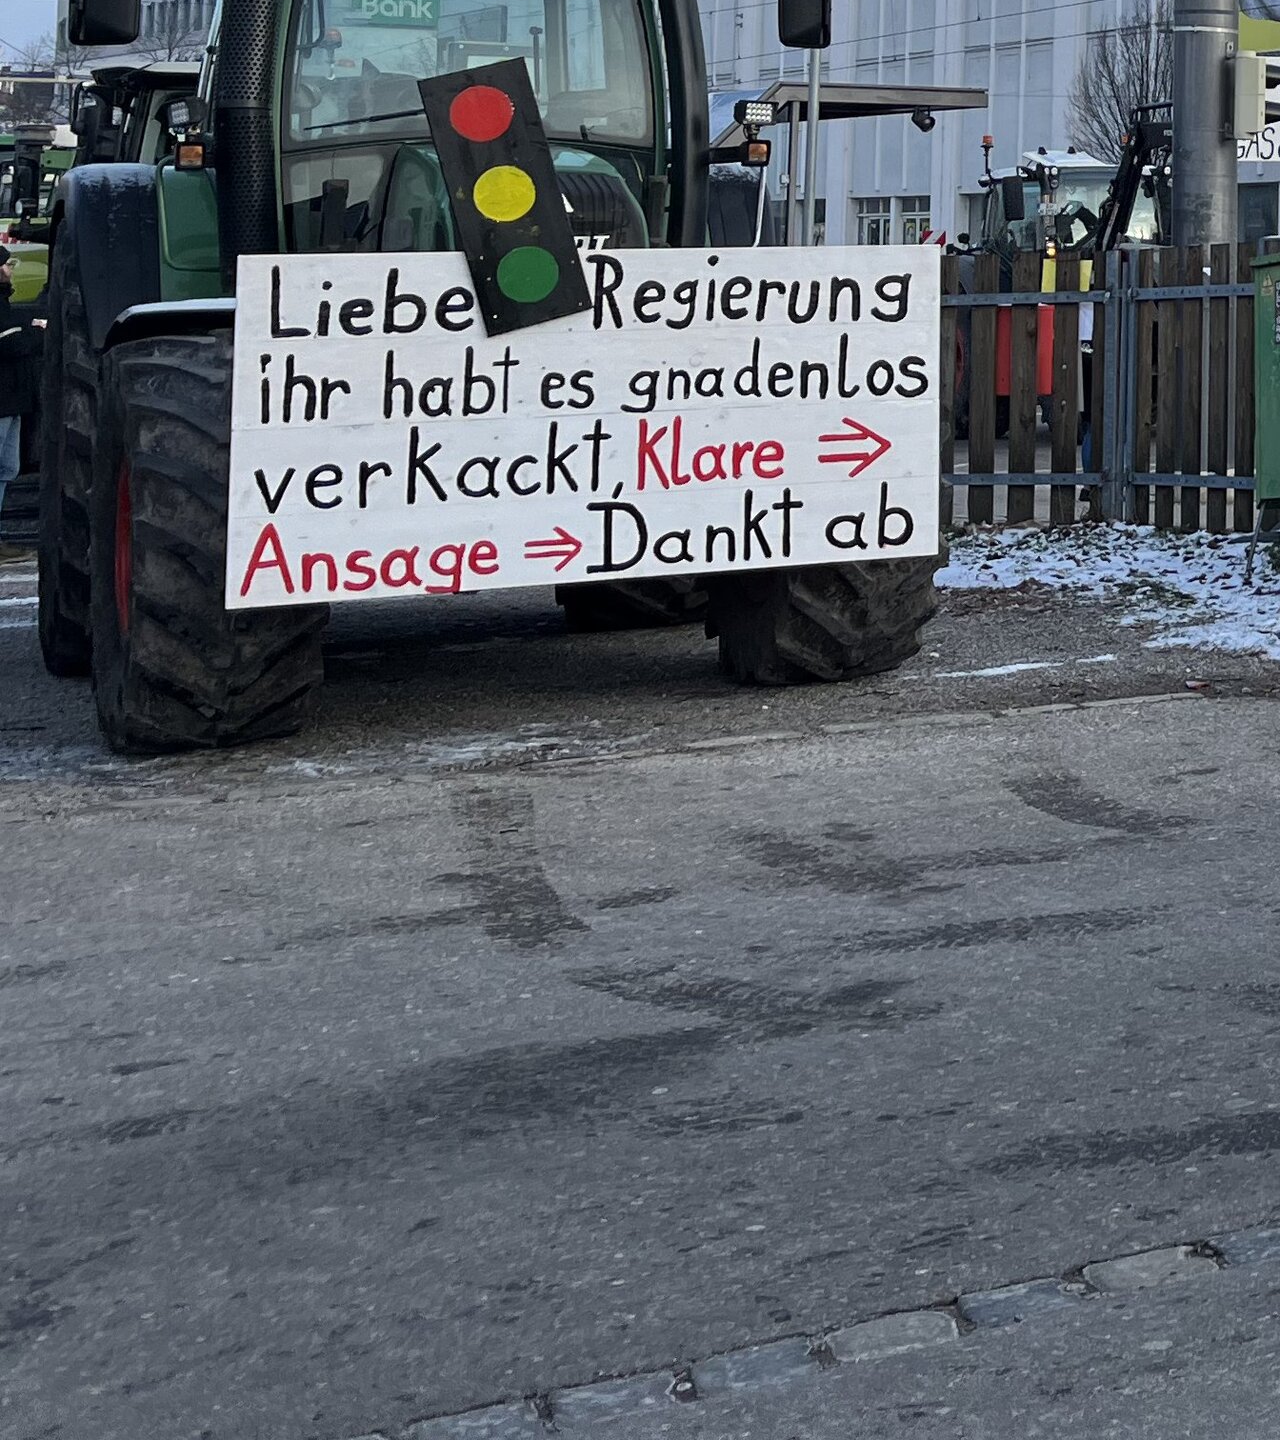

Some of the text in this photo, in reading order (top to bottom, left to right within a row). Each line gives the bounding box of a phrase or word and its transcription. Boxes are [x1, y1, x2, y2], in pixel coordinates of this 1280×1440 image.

[271, 254, 912, 338] Liebe Regierung
[260, 333, 929, 424] ihr habt es gnadenlos
[637, 416, 786, 490] Klare
[240, 481, 915, 597] Ansage Dankt ab
